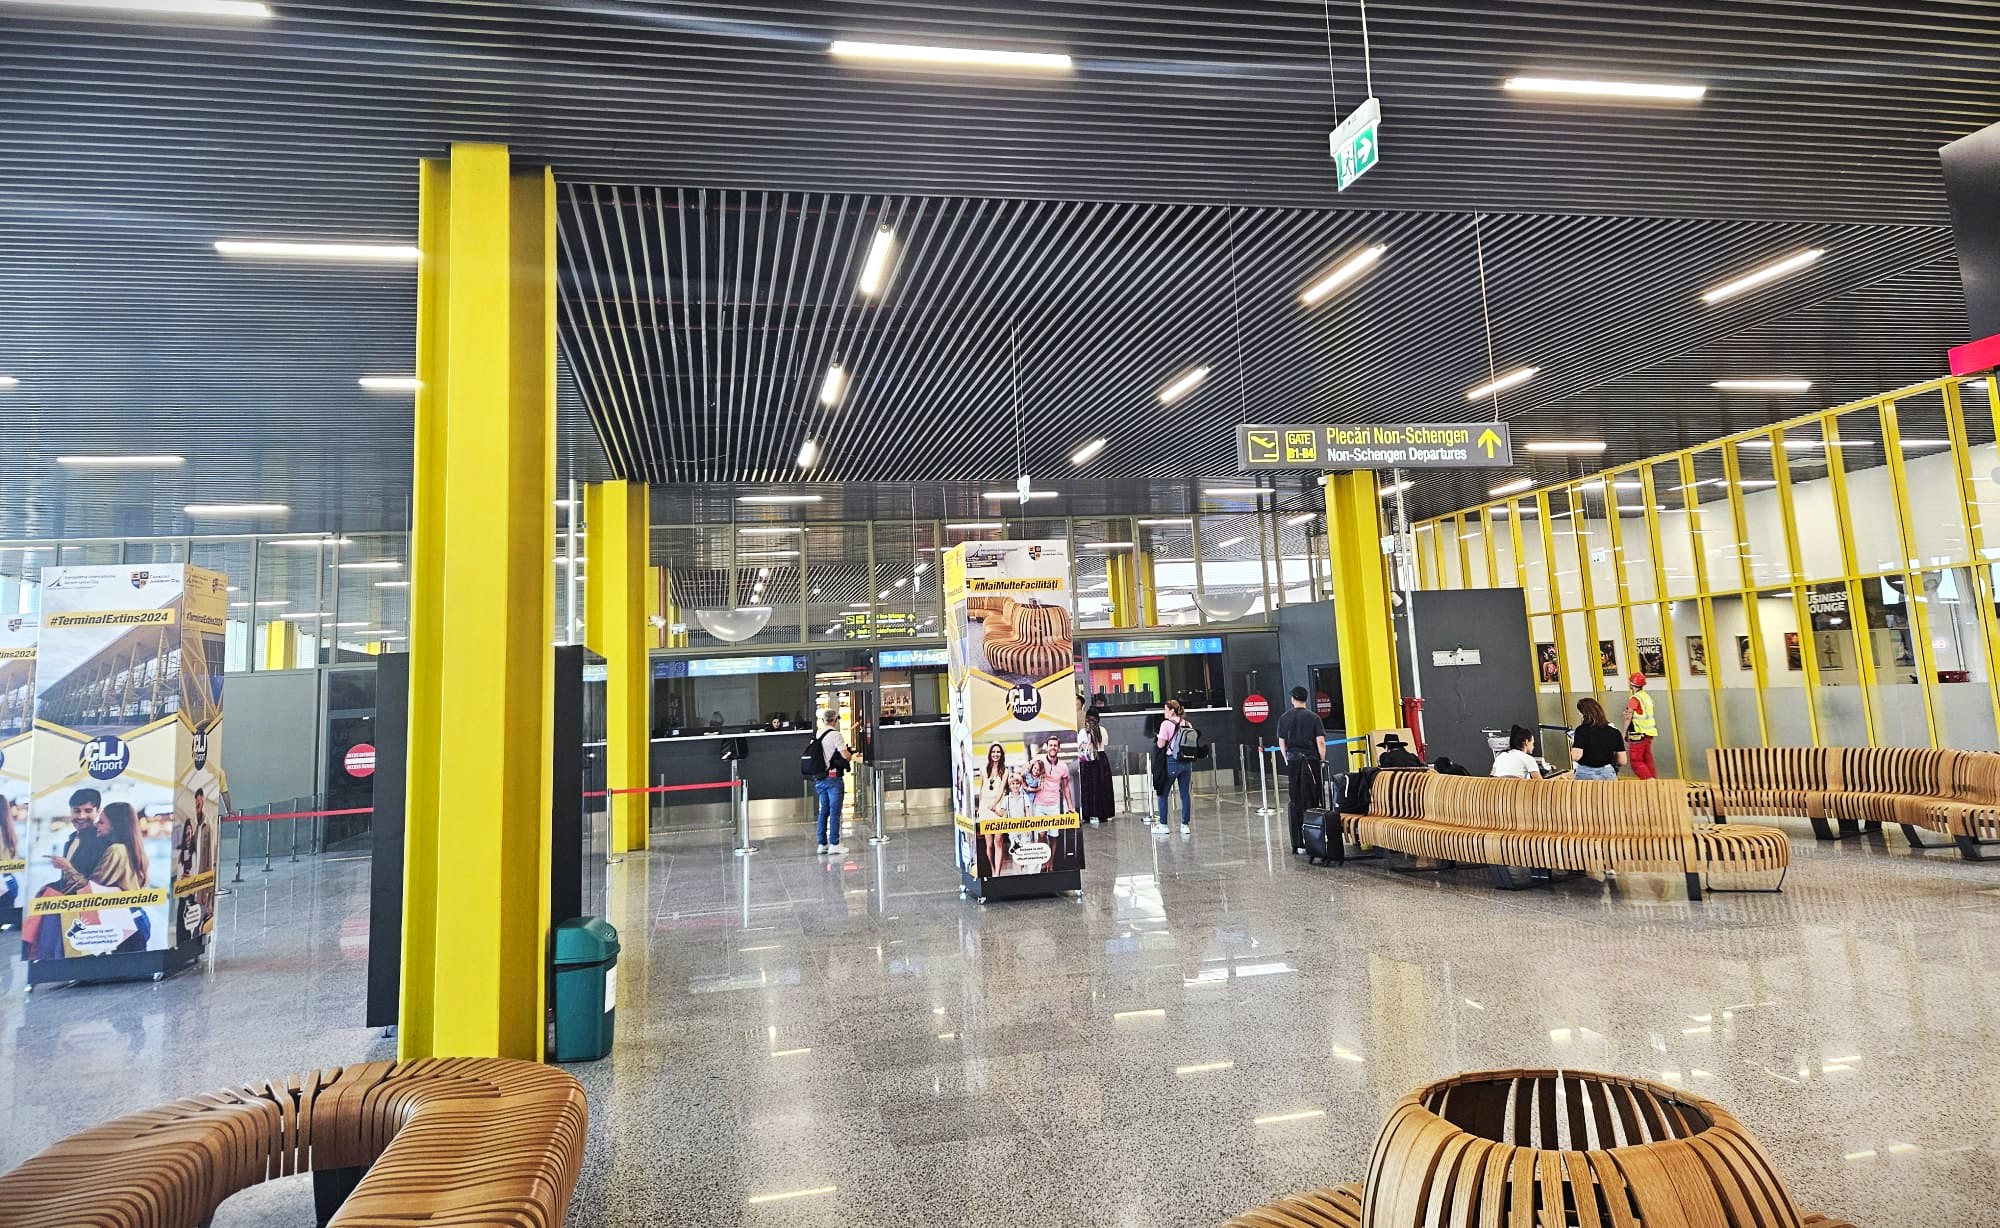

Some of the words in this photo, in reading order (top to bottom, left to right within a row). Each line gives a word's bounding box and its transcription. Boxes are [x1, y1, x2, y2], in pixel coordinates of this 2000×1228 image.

[1288, 433, 1311, 445] GATE
[1326, 427, 1370, 446] Plecări
[1374, 428, 1469, 447] Non-Schengen
[1288, 447, 1315, 459] B1-B4
[1327, 447, 1407, 464] Non-Schengen
[1409, 446, 1467, 462] Departures
[1808, 591, 1848, 605] USINESS
[1809, 602, 1846, 614] OUNGE
[50, 611, 169, 627] #TerminalExtins2024
[1635, 637, 1662, 647] SINESS
[1636, 645, 1661, 655] OUNGE
[1008, 688, 1038, 706] CLJ
[1013, 704, 1038, 715] Airport
[84, 740, 125, 762] CLJ
[88, 760, 123, 773] Airport
[33, 892, 159, 912] #NoiSpațiiComerciale
